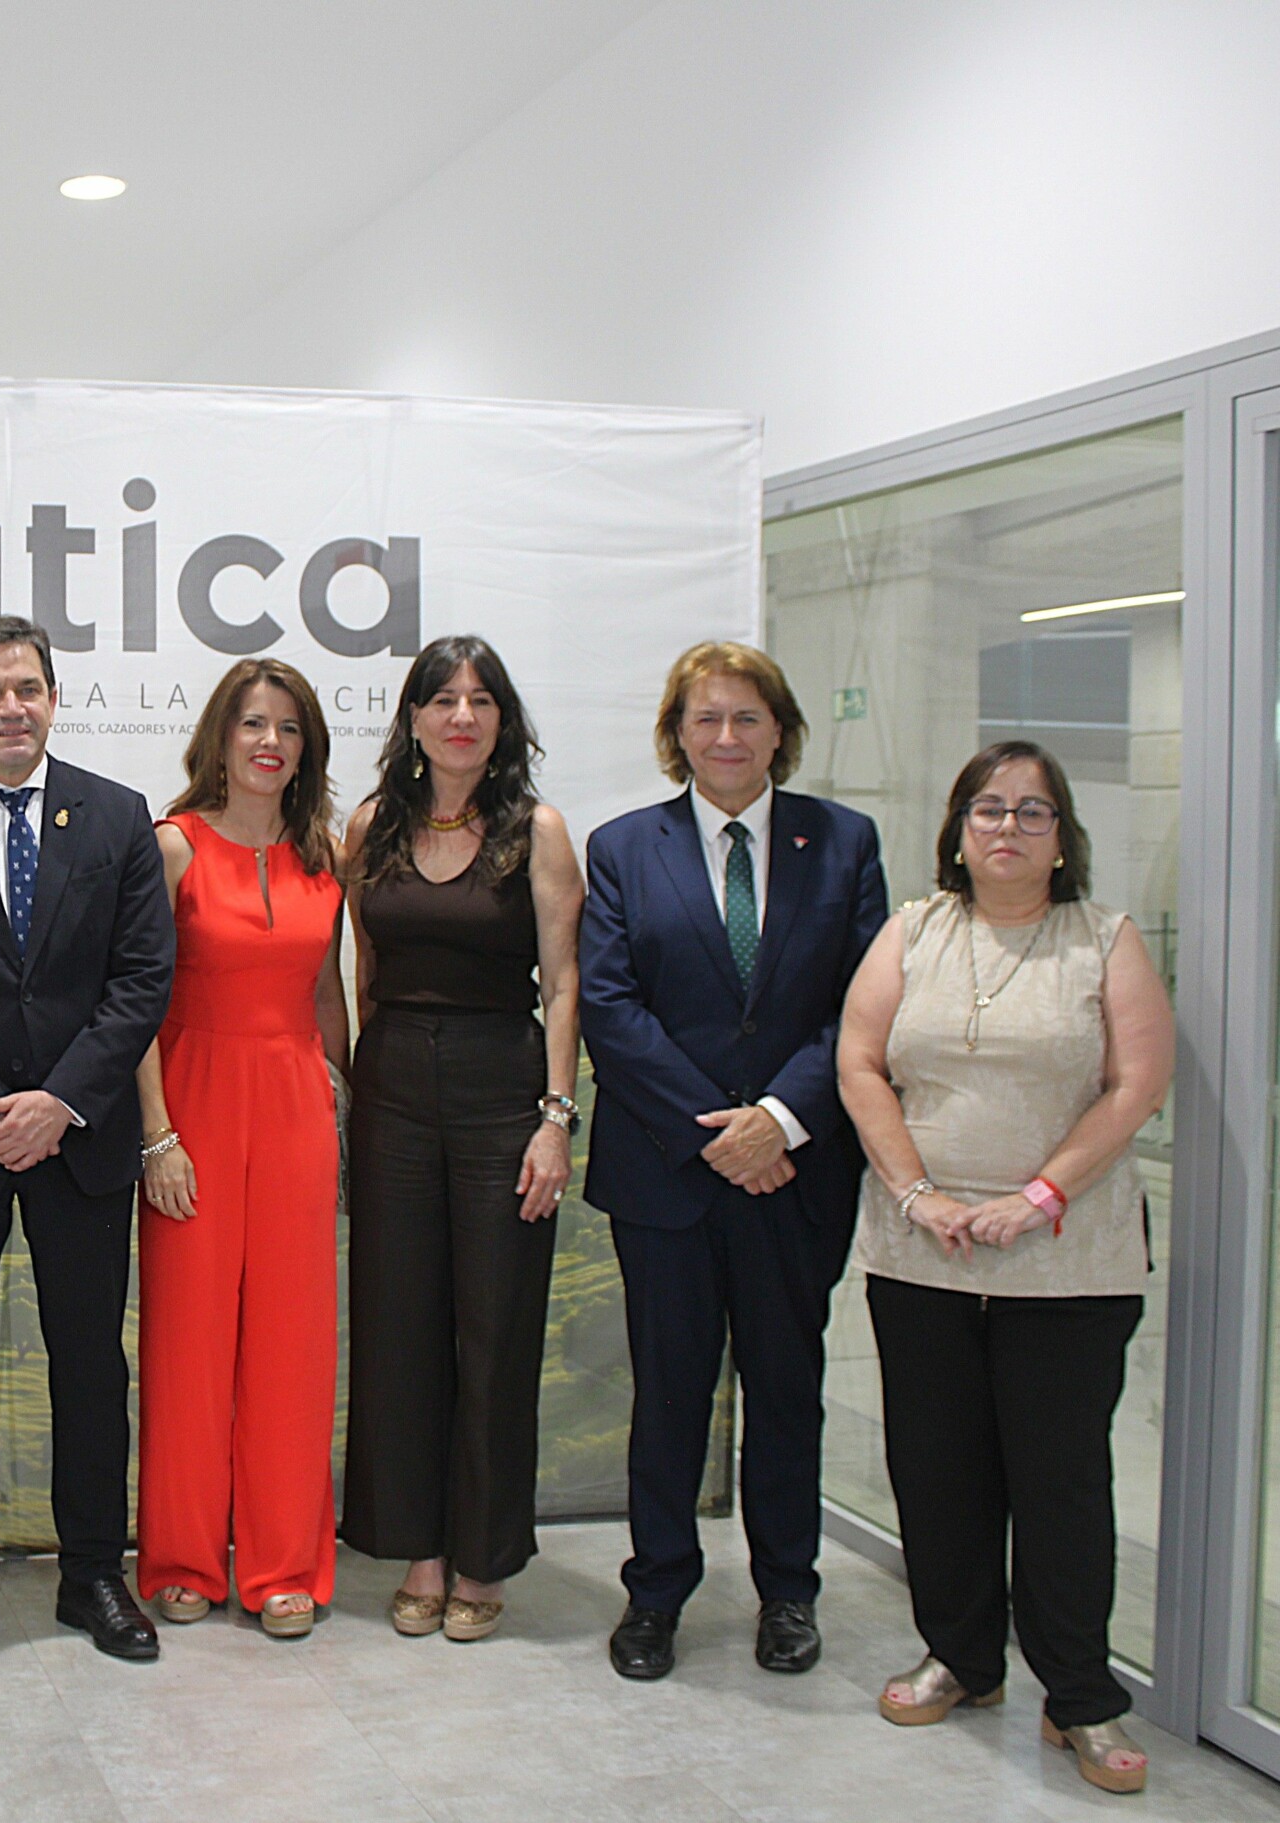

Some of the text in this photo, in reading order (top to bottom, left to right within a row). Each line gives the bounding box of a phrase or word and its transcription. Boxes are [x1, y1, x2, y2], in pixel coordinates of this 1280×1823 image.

[140, 683, 188, 709] LA
[53, 722, 95, 736] COTOS,
[98, 723, 166, 735] CAZADORES
[169, 725, 176, 735] Y
